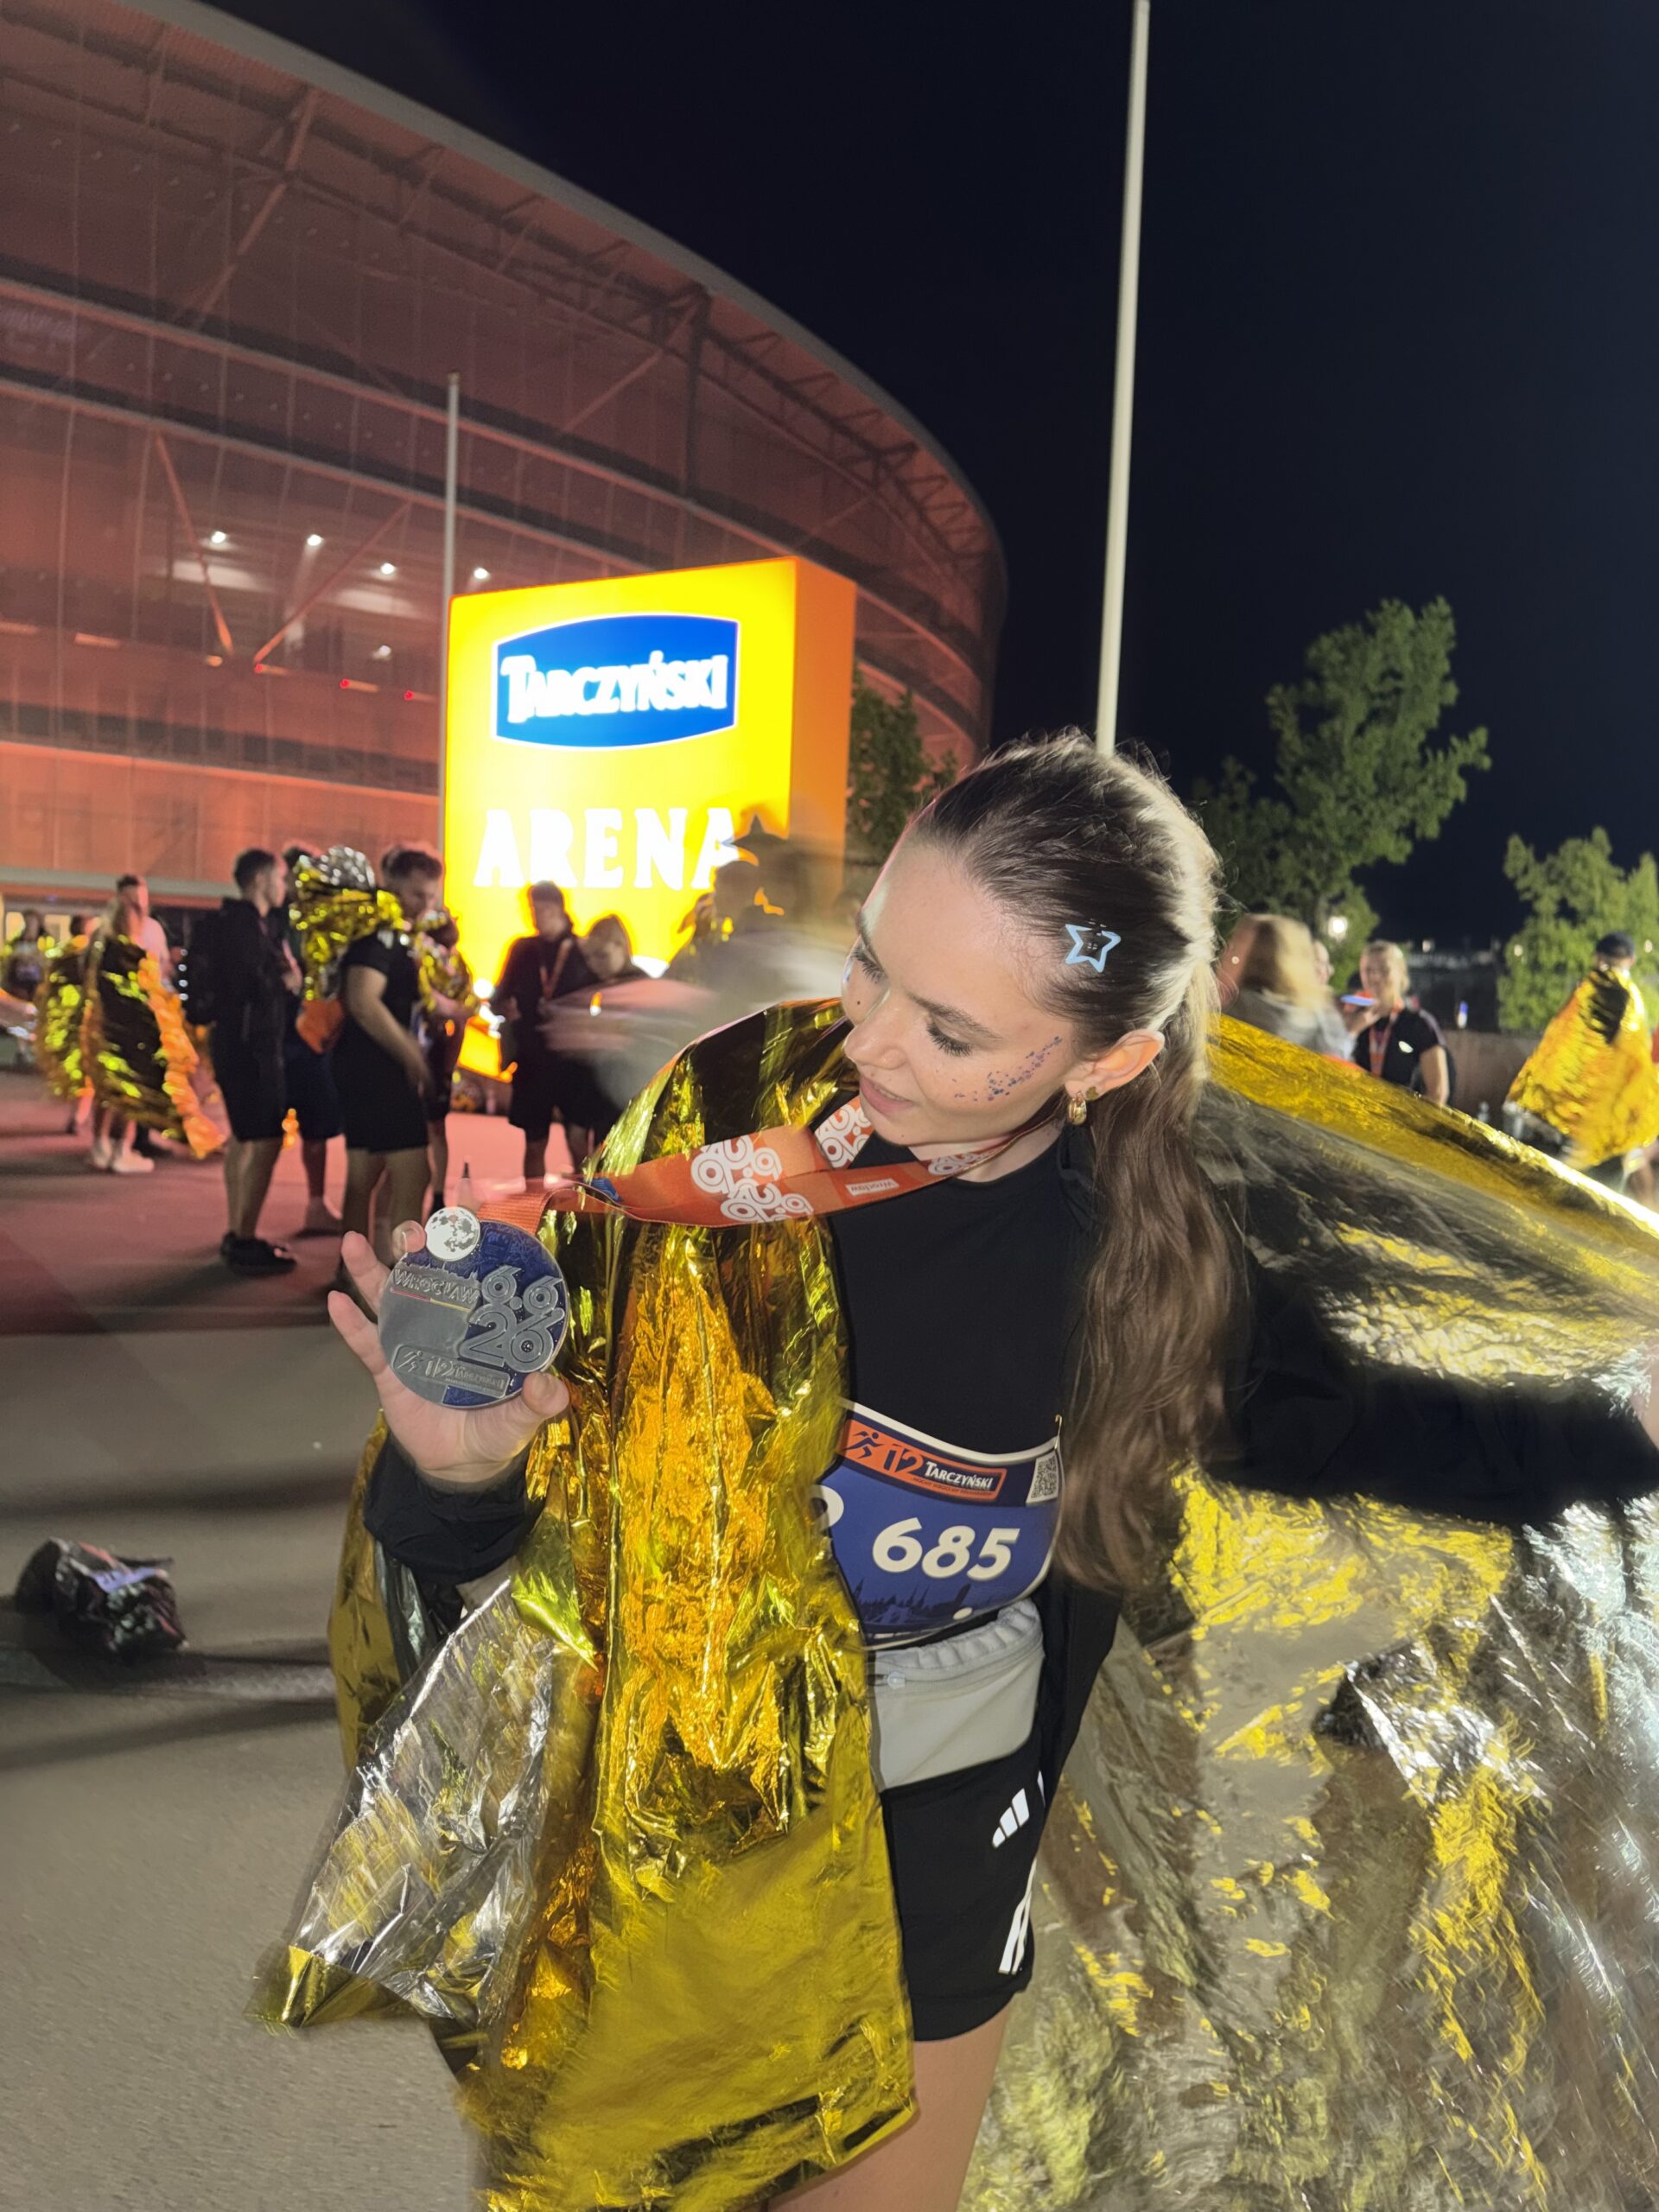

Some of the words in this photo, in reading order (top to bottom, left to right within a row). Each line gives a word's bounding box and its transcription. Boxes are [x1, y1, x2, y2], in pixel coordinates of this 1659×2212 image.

[473, 807, 739, 890] ARENA
[925, 1460, 994, 1489] TARCZYŃSKI
[872, 1517, 1020, 1580] 685
